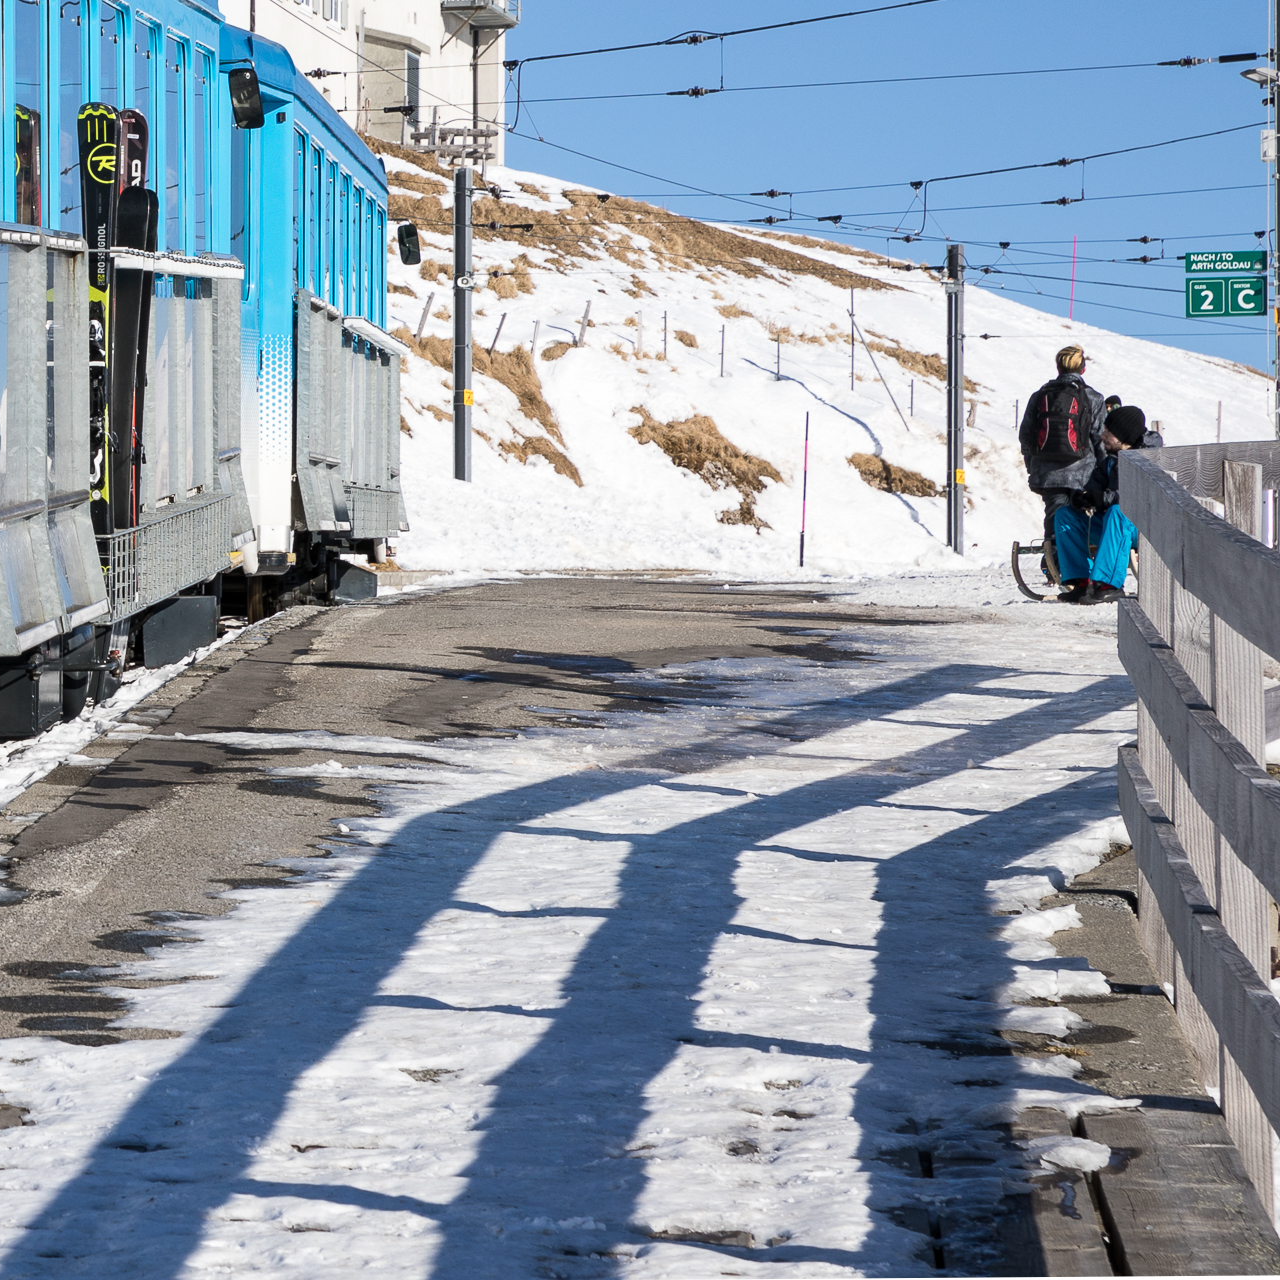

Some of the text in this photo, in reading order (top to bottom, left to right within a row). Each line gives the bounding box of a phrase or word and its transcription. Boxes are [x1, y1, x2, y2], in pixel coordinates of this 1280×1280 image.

[1221, 253, 1233, 261] TO
[1191, 261, 1251, 270] ARTH GOLDAU
[1200, 290, 1214, 310] 2
[1237, 289, 1255, 309] C
